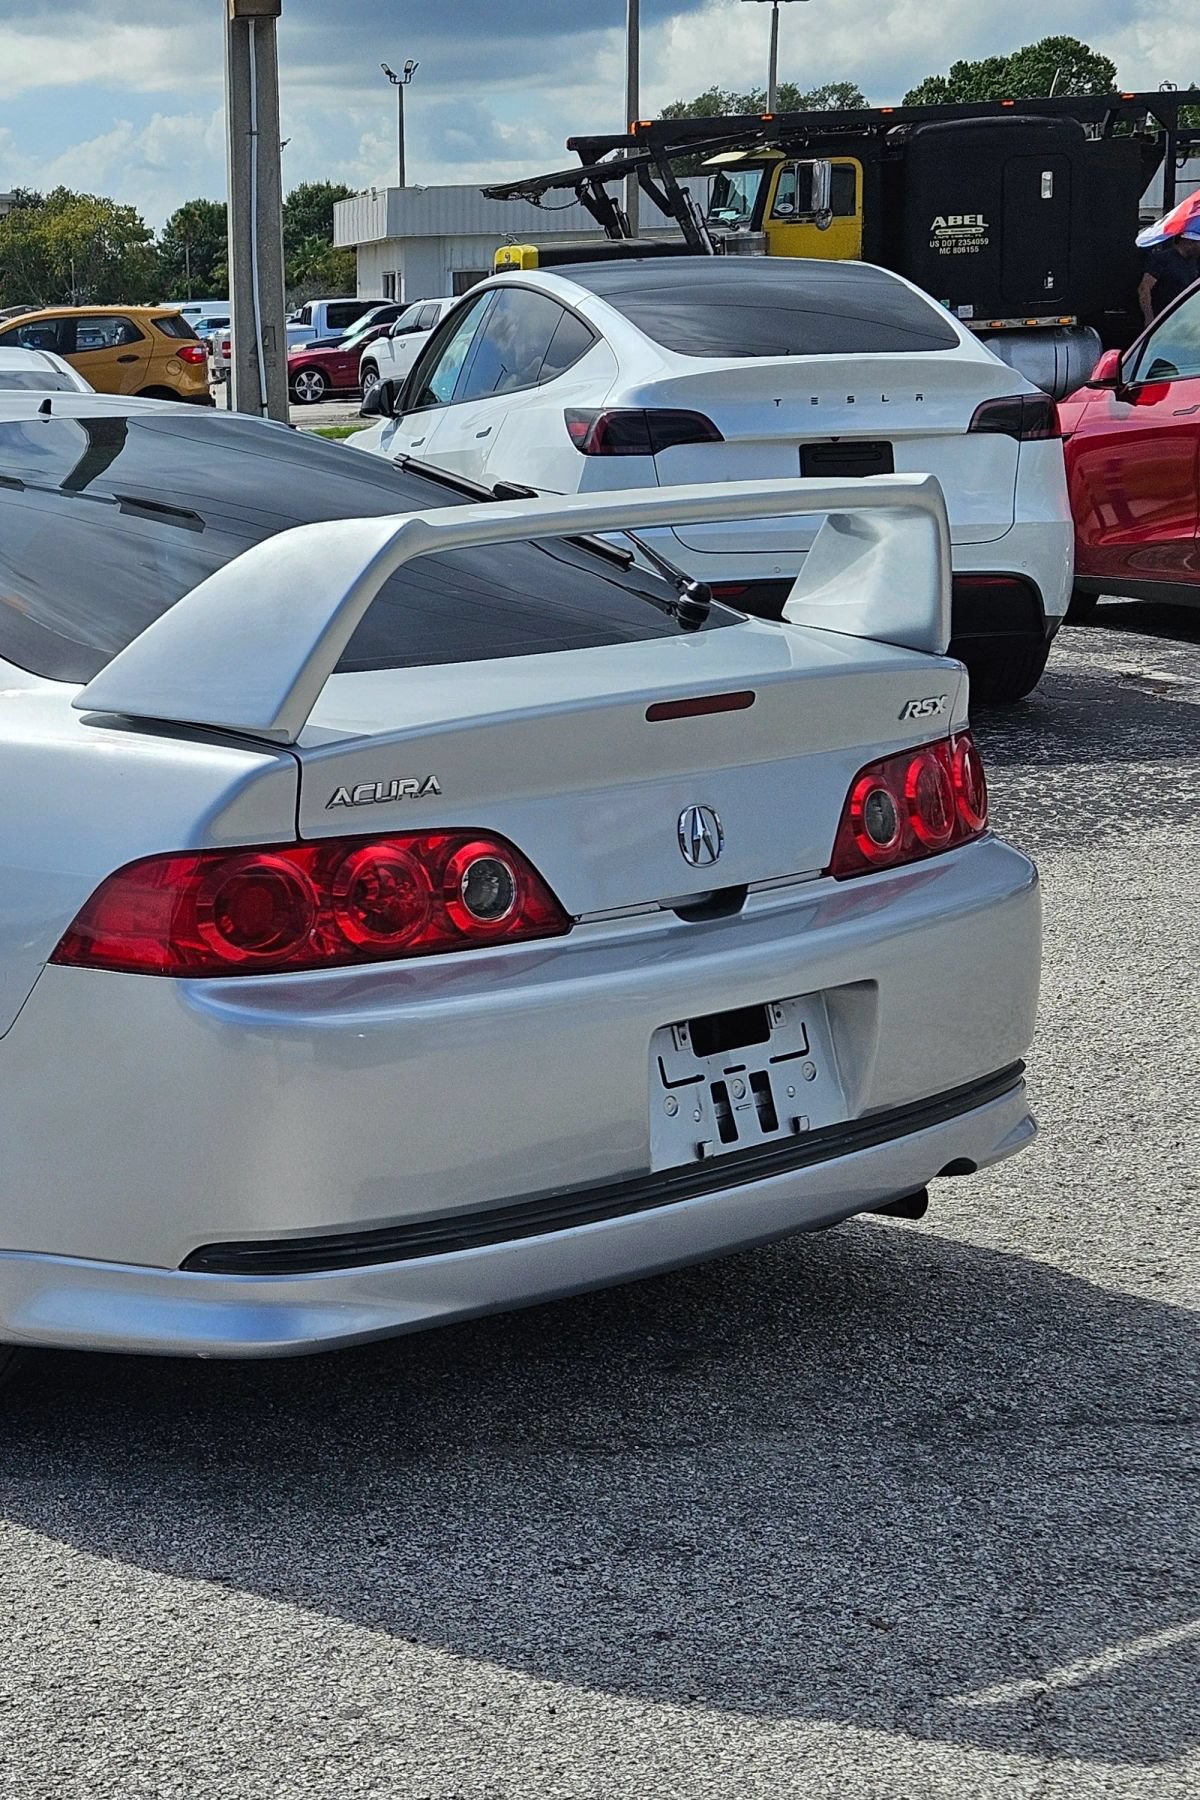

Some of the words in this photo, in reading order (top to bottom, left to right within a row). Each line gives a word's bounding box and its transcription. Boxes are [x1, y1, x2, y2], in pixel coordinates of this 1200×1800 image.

[930, 214, 989, 231] ABEL
[929, 240, 940, 248] US
[941, 239, 956, 247] DOT
[958, 237, 989, 246] 2354059
[939, 247, 951, 255] MC
[773, 393, 924, 407] TESLA
[898, 694, 948, 720] RSX
[325, 775, 442, 809] ACURA
